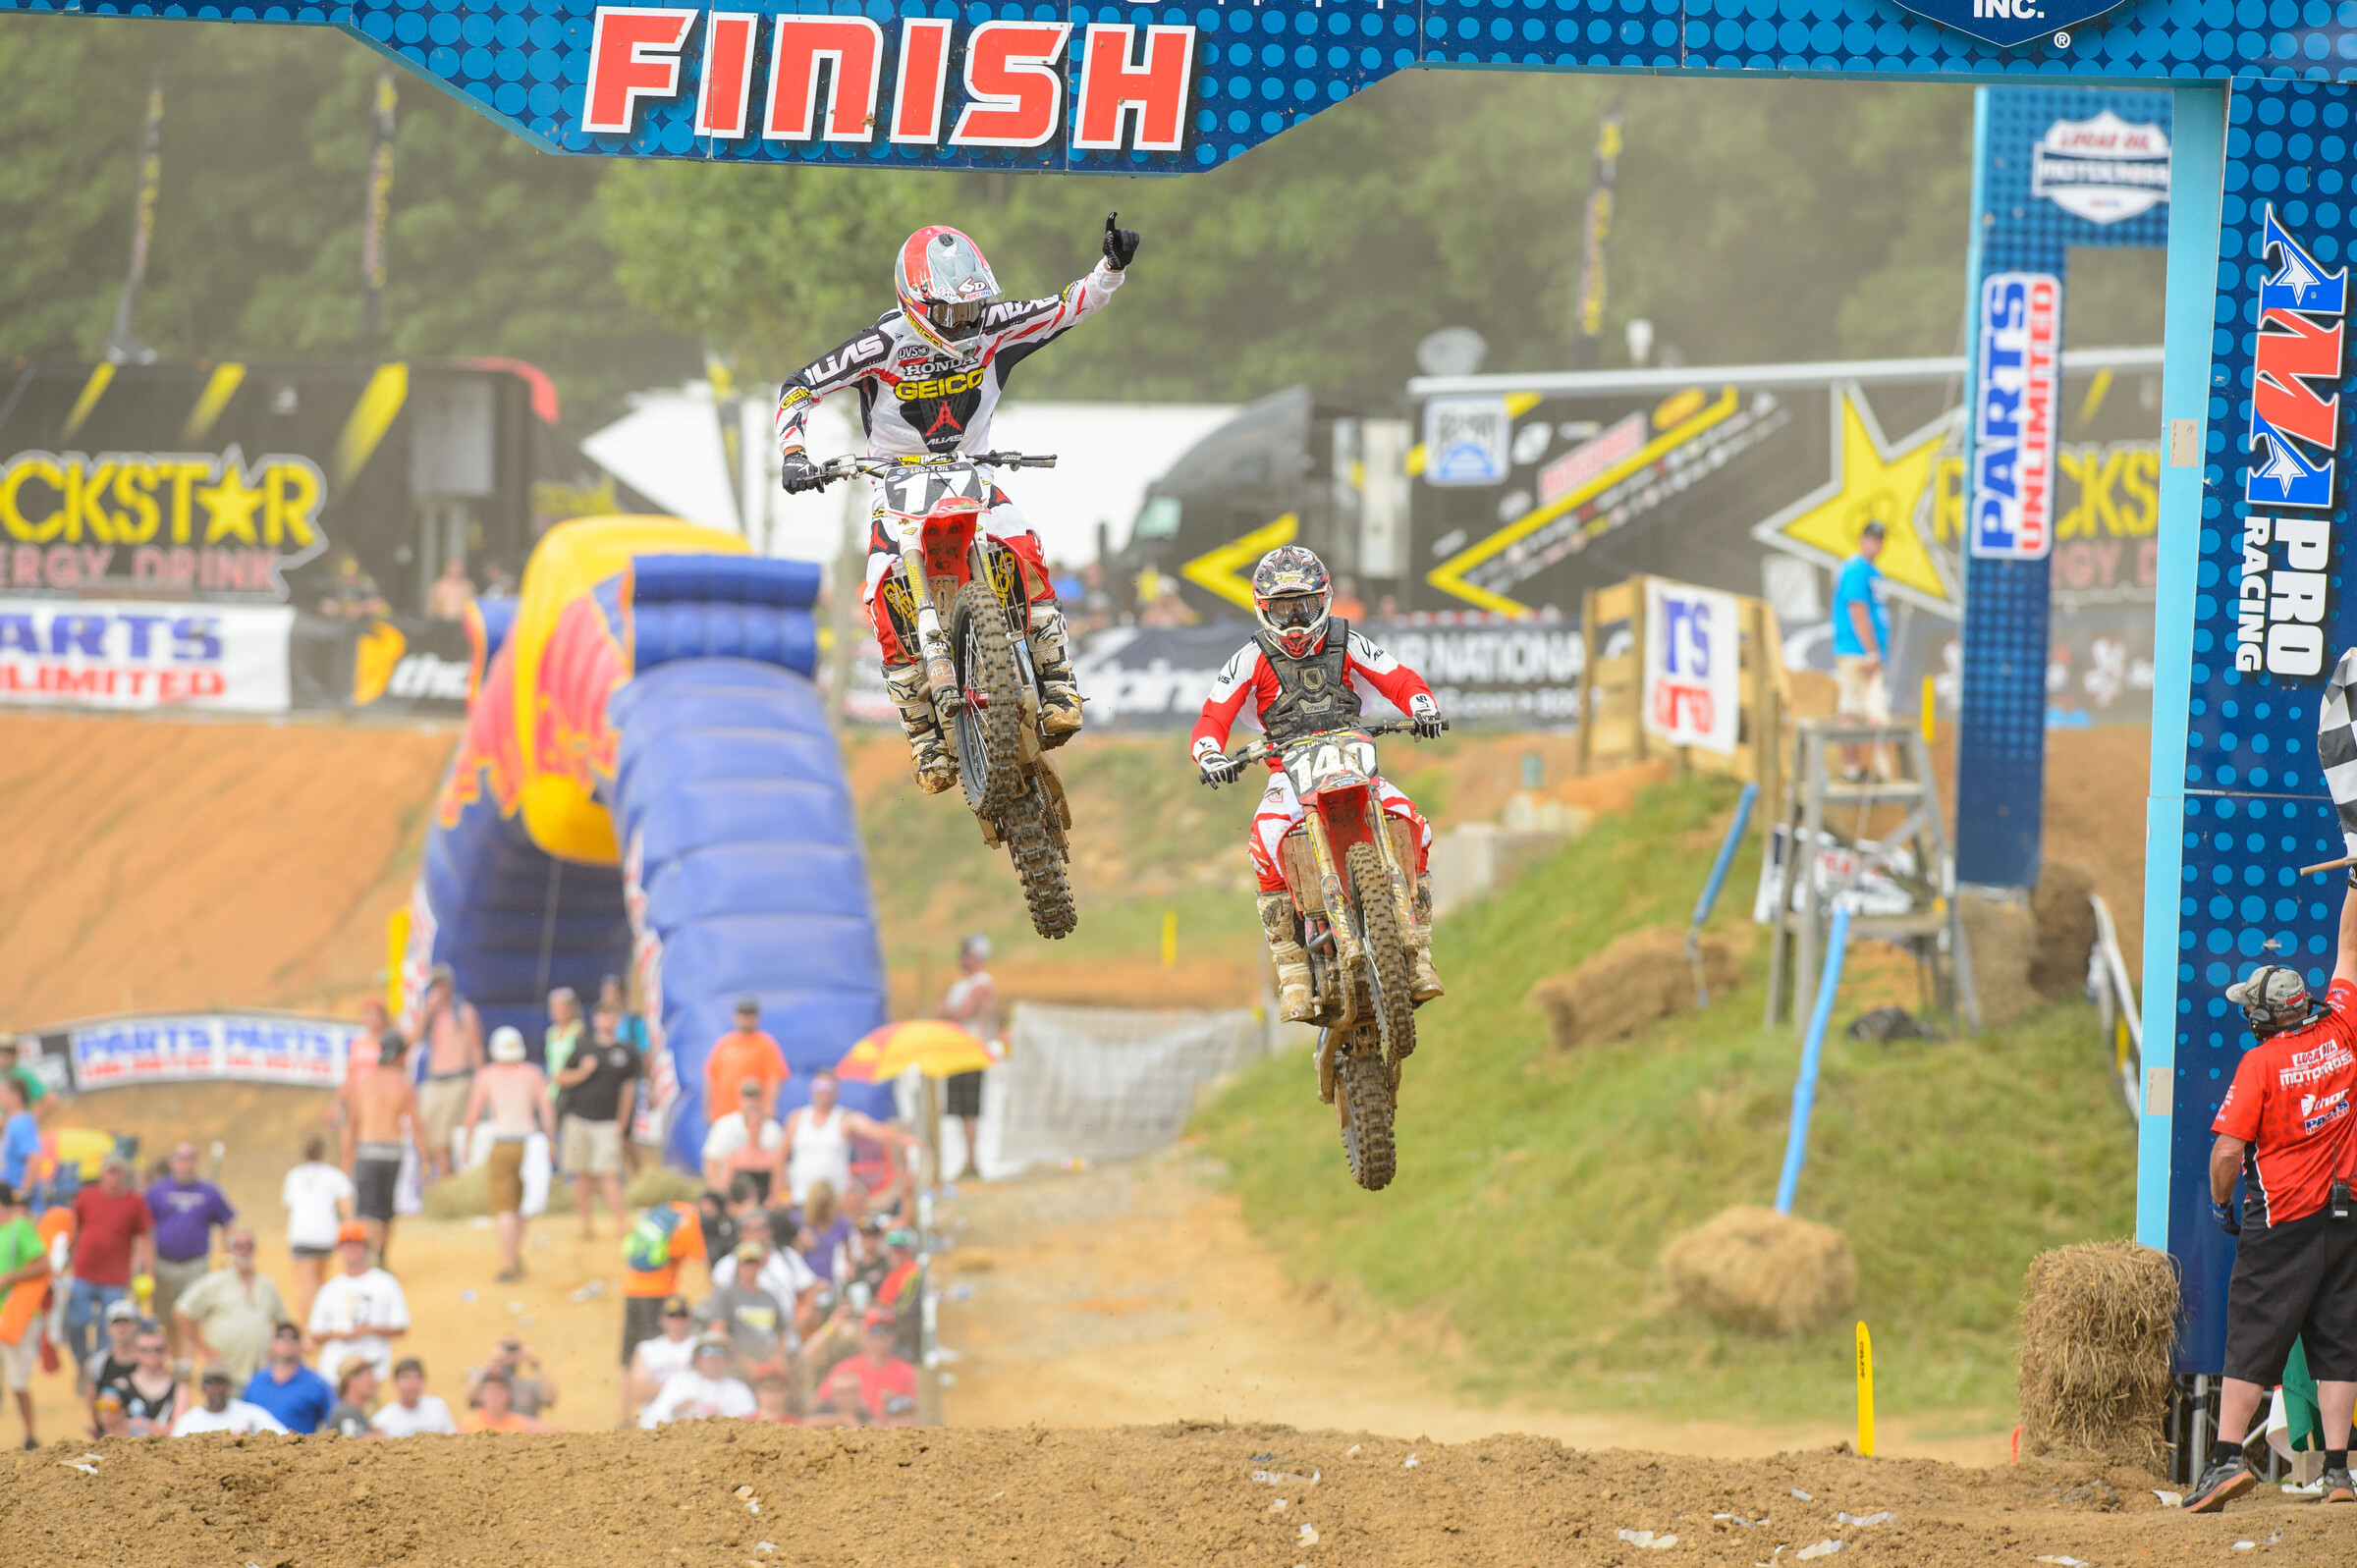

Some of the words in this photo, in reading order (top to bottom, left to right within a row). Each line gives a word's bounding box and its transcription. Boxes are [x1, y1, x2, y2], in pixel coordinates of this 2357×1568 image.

[581, 7, 1196, 151] FINISH
[898, 345, 919, 360] DVS
[904, 356, 979, 376] HONDA
[2245, 201, 2348, 508] AMA
[895, 367, 986, 401] GEICO
[1980, 282, 2025, 550] PARTS
[2021, 282, 2054, 551] UNLIMITED
[894, 470, 972, 514] 17
[2235, 515, 2271, 673] RACING
[2266, 517, 2330, 676] PRO
[0, 665, 226, 697] LIMITED
[1289, 741, 1377, 794] 140
[2314, 1088, 2350, 1110] thor
